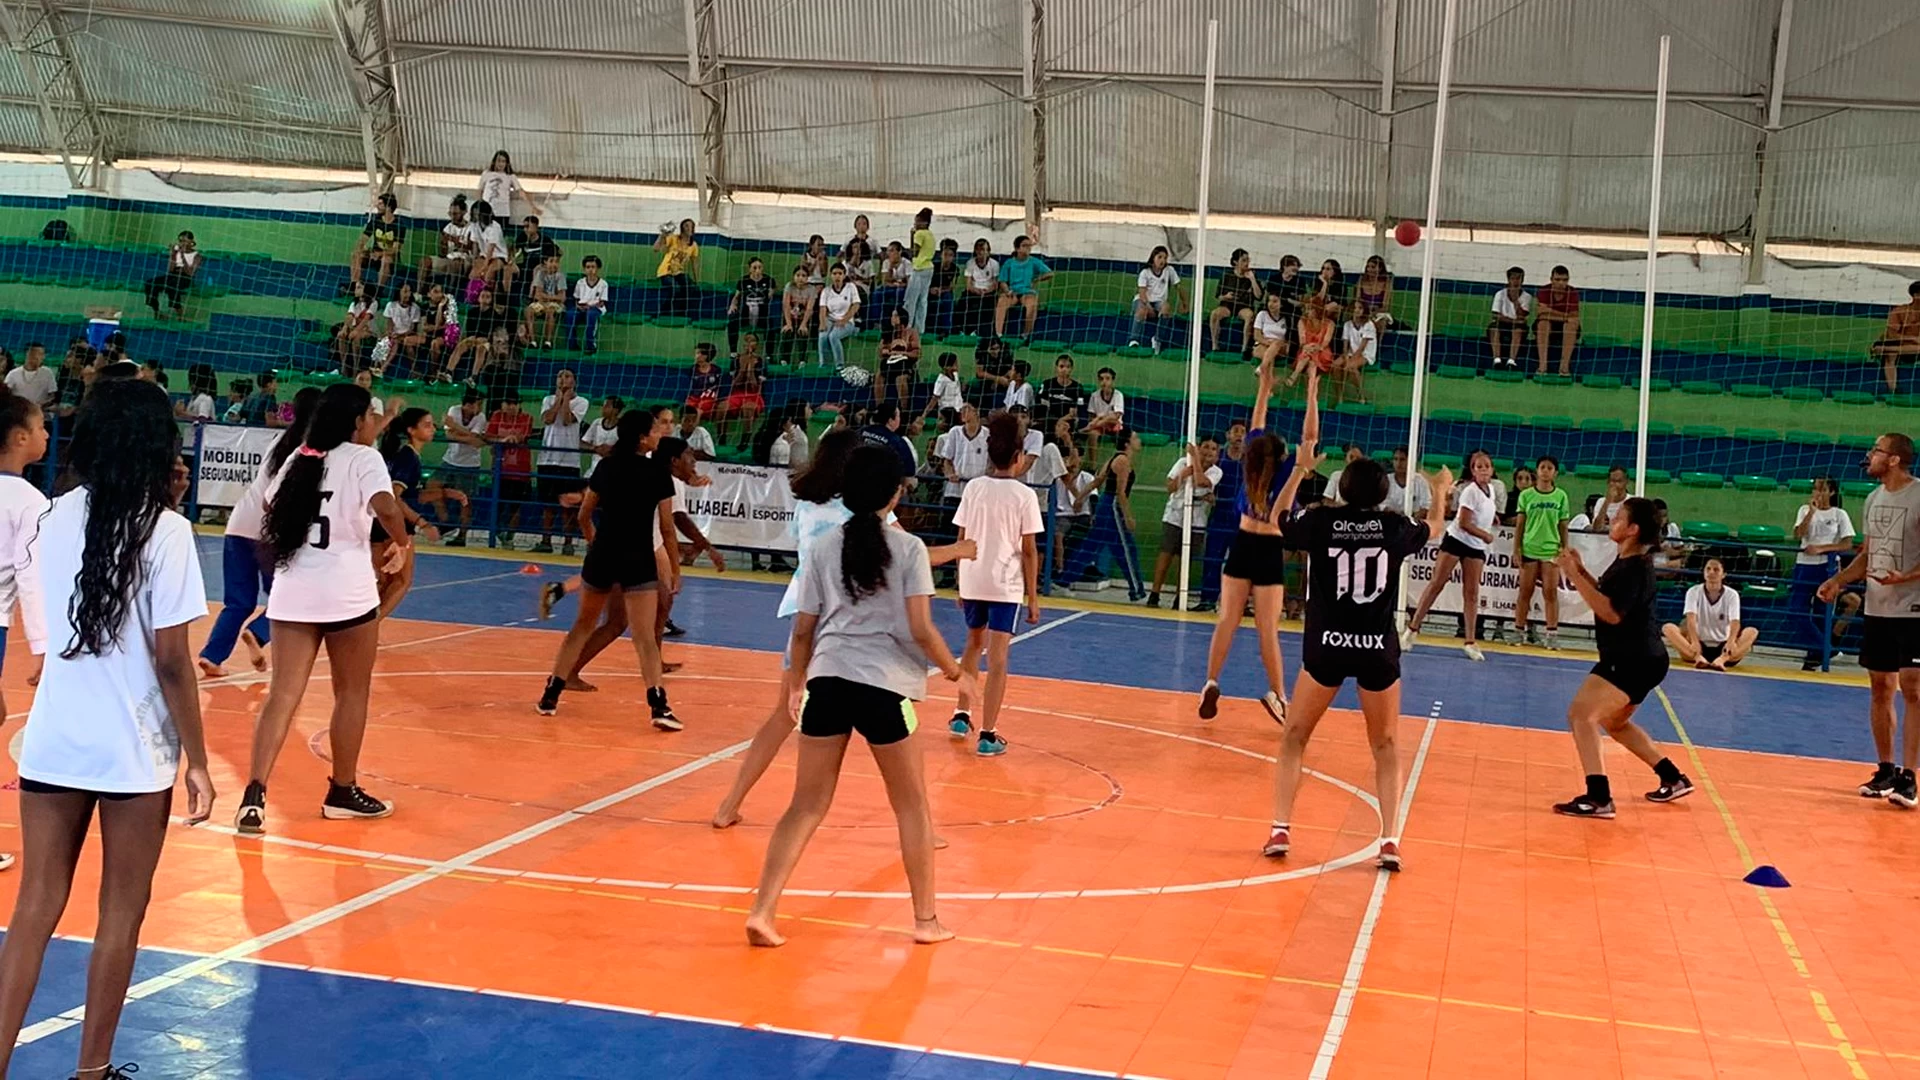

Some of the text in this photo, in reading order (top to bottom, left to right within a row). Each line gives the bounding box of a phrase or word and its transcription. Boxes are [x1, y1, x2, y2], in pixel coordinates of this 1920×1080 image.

[203, 450, 262, 466] MOBILID
[1328, 547, 1388, 604] 10
[1321, 630, 1384, 649] FOXLUX
